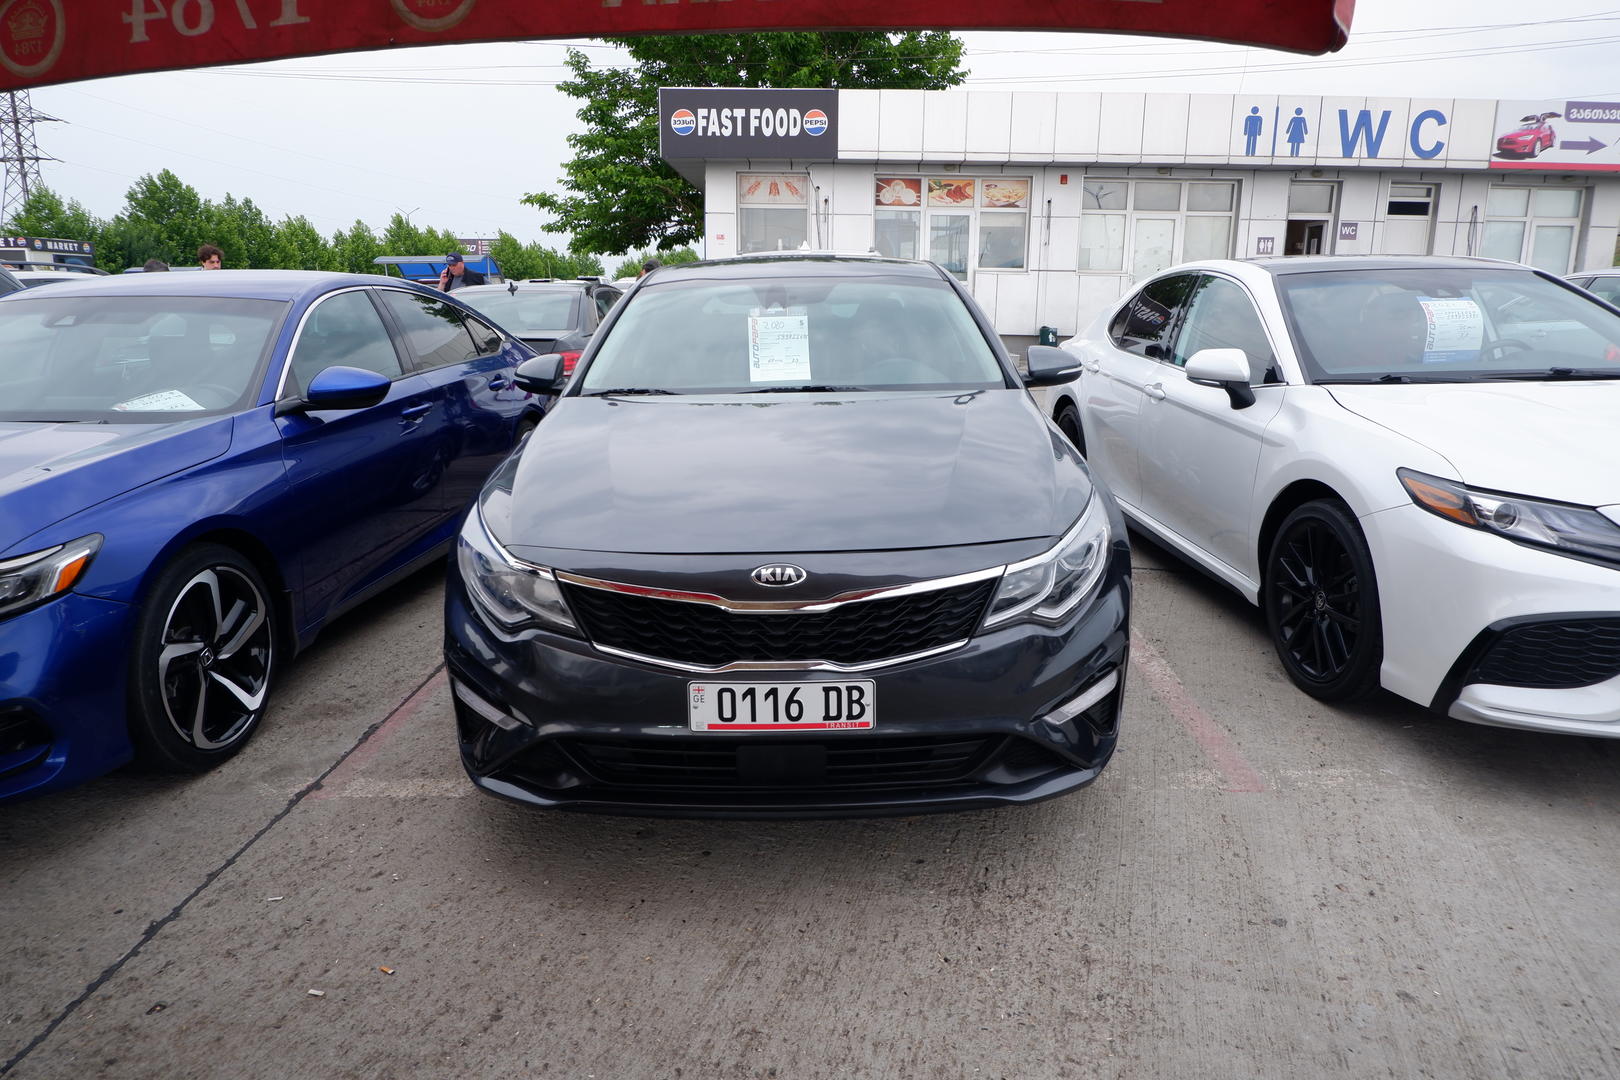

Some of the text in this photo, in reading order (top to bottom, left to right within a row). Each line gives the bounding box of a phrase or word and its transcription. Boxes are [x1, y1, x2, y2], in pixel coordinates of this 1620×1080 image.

[697, 108, 801, 137] FAST FOOD
[1341, 226, 1356, 235] WC
[46, 241, 79, 251] MARKET
[760, 567, 798, 582] KIA
[693, 695, 705, 703] GE
[717, 685, 866, 722] 0116 DB
